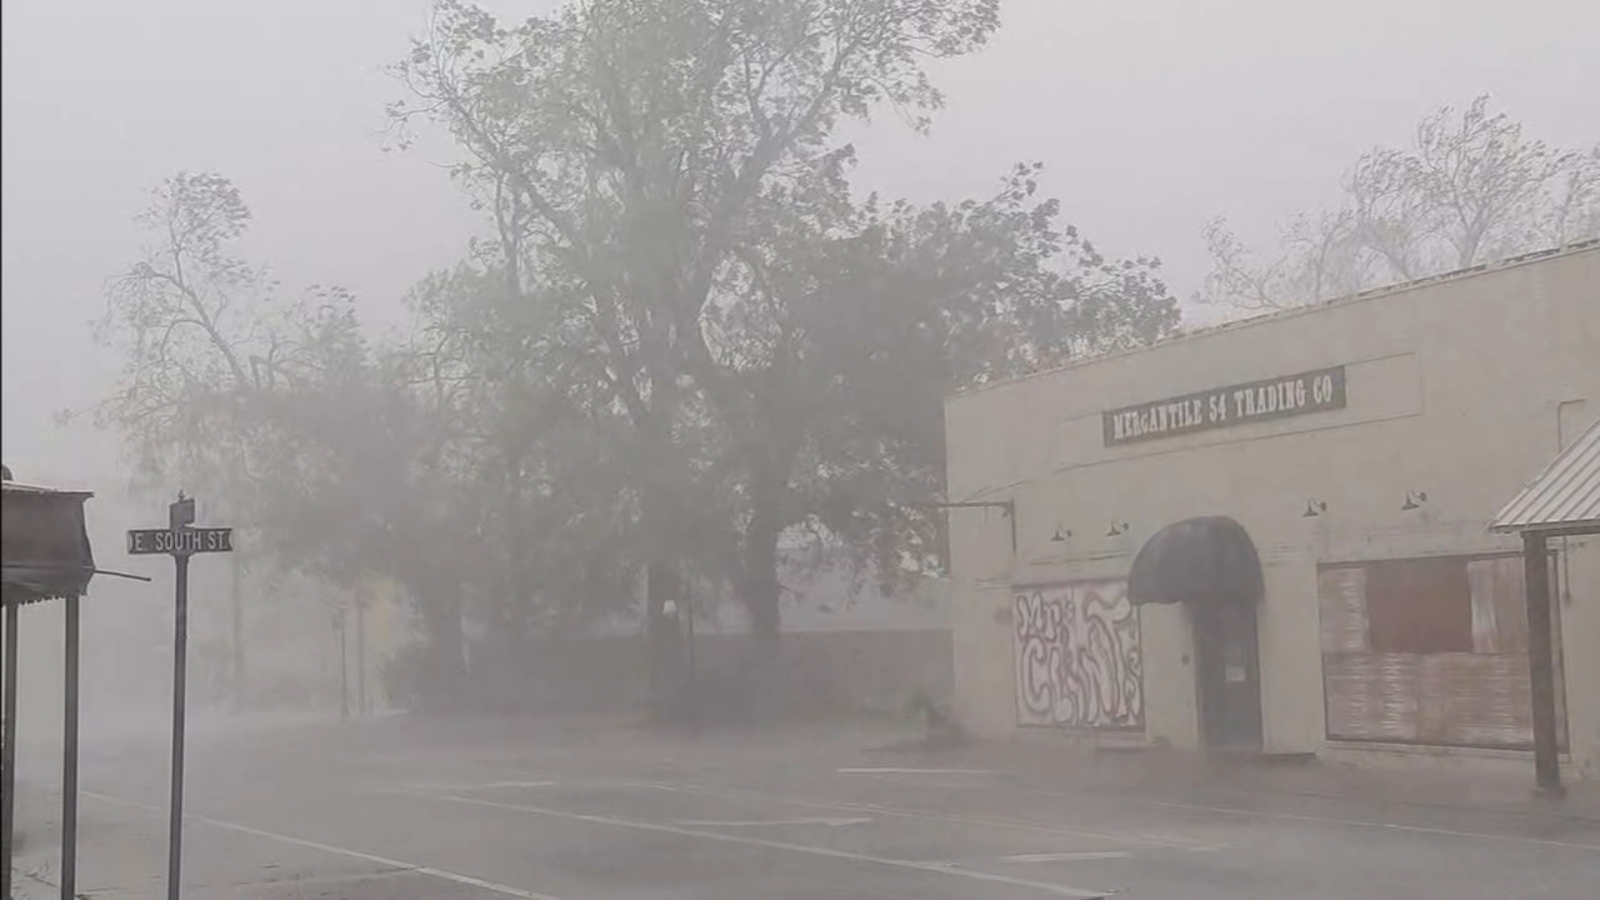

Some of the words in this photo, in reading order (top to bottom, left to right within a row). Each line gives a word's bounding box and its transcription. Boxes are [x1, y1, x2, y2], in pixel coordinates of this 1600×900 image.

[1113, 400, 1201, 440] MERCANTILE
[1209, 394, 1226, 422] 54
[1234, 379, 1306, 418] TRADING
[1313, 375, 1333, 405] CO
[155, 532, 202, 551] SOUTH
